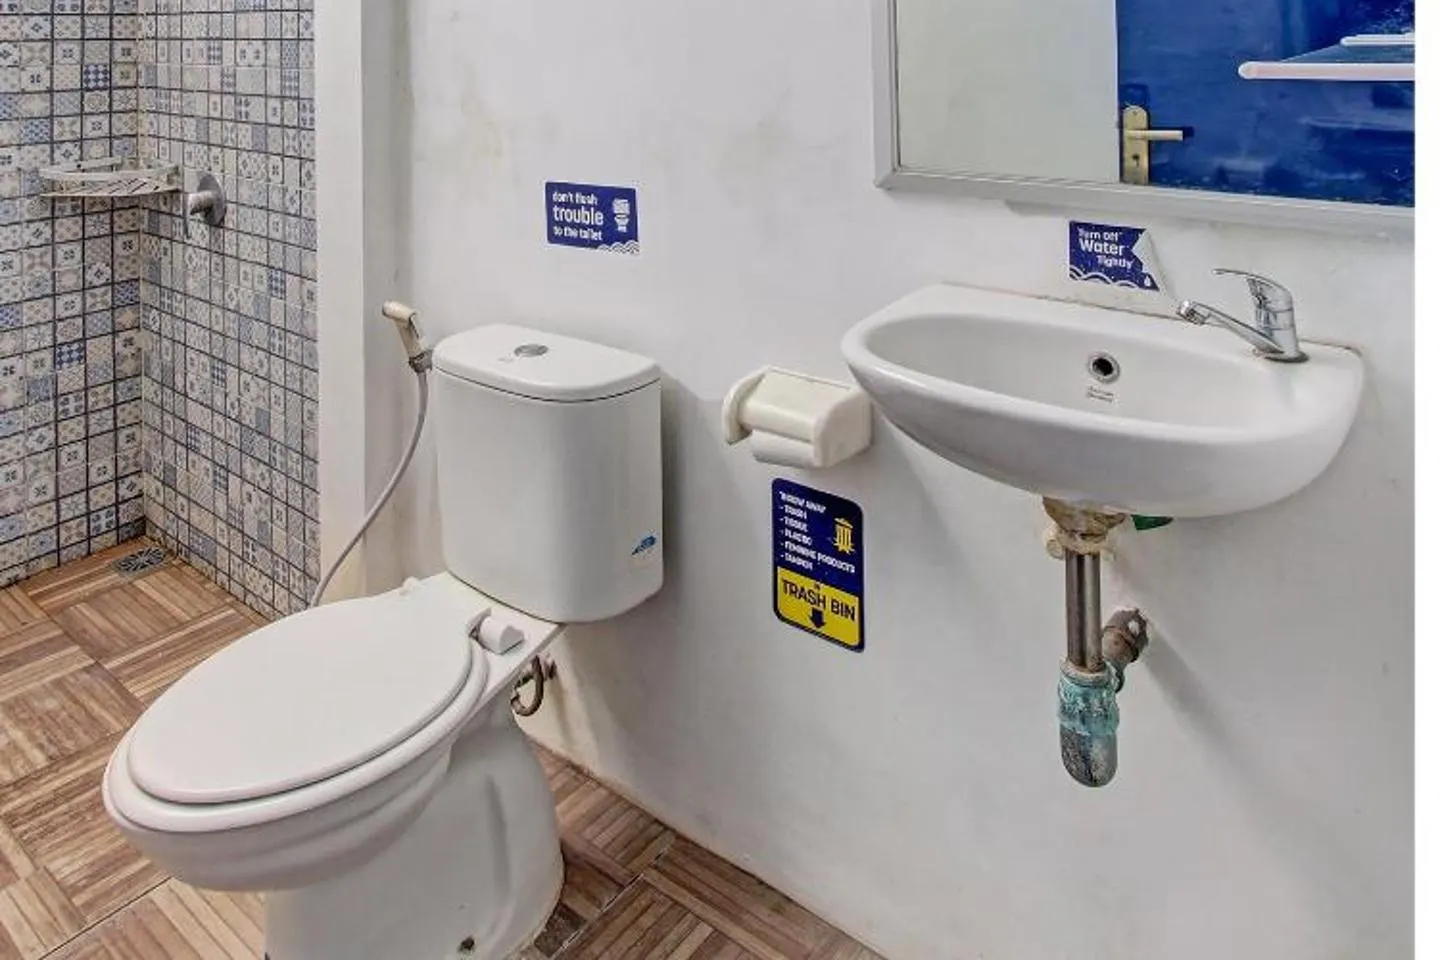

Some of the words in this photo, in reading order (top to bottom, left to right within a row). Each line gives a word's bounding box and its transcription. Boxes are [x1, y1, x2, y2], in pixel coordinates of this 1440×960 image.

[553, 205, 604, 226] trouble
[1079, 238, 1125, 256] Water
[782, 578, 827, 611] TRASH
[831, 600, 856, 622] BIN
